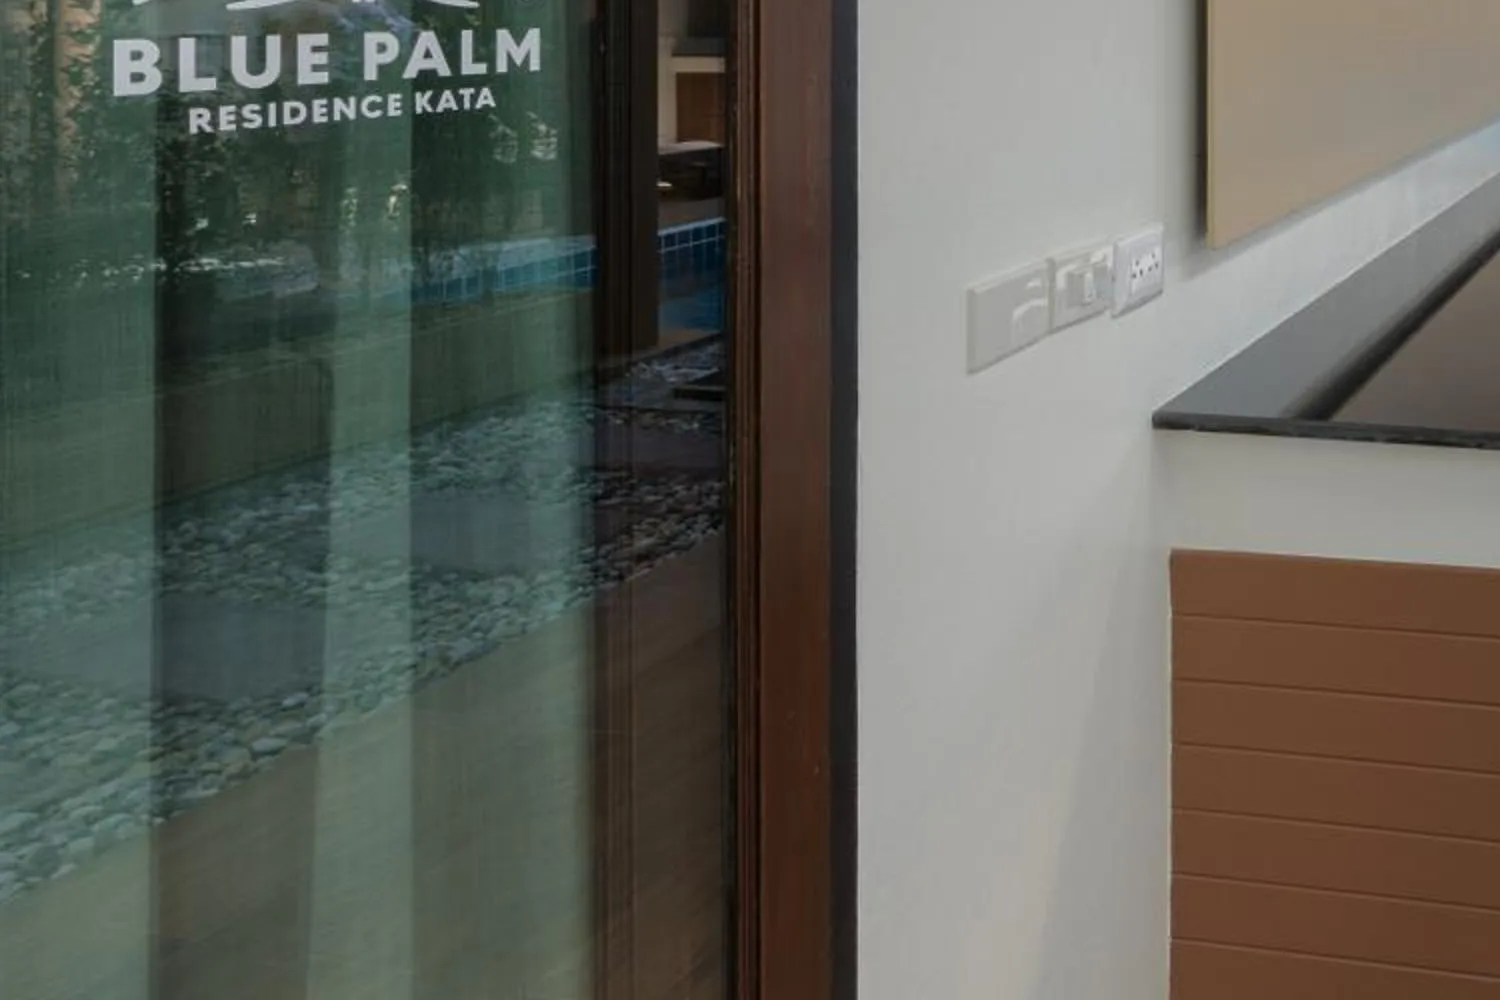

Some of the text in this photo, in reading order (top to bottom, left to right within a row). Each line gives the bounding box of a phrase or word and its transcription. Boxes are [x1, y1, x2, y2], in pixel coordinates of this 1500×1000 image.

[112, 26, 542, 98] BLUE PALM
[188, 86, 497, 136] RESIDENCE KATA
